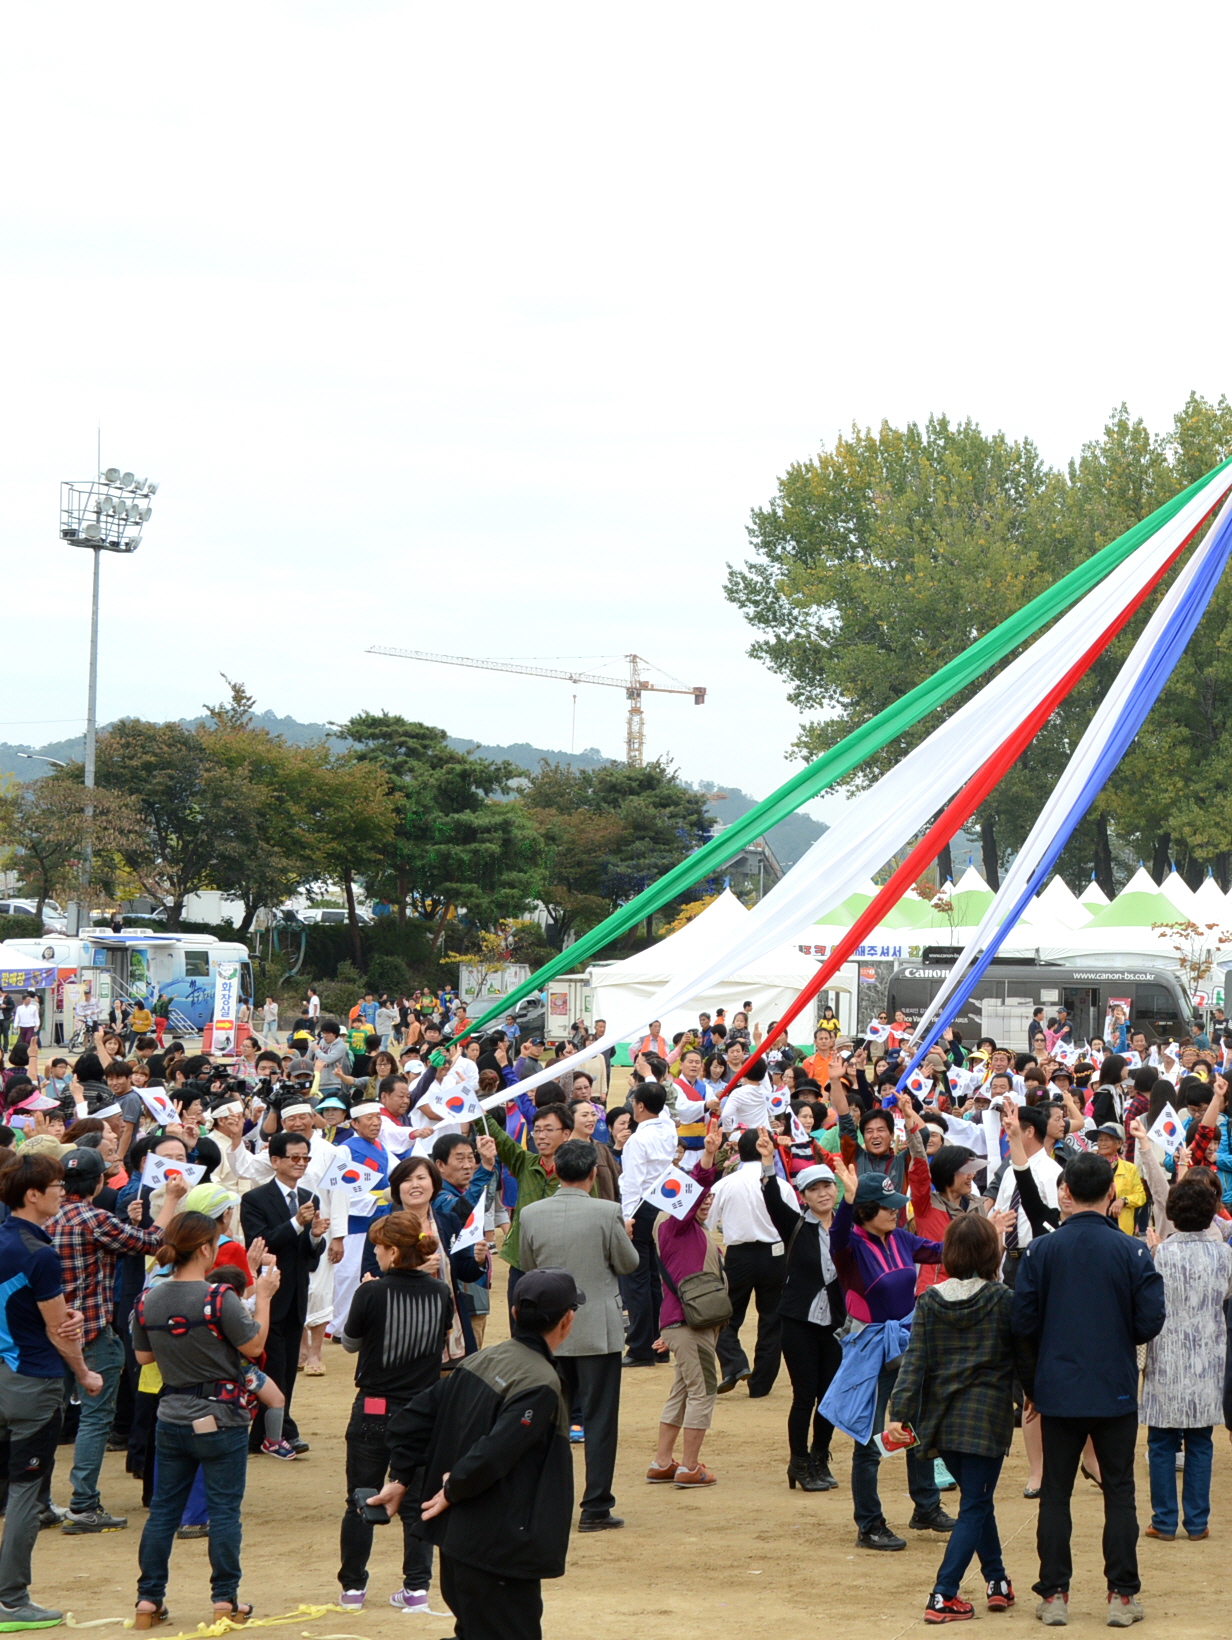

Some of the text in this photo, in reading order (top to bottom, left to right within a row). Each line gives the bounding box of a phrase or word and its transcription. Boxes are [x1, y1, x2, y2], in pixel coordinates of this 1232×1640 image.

[904, 968, 950, 978] Canon
[1073, 971, 1156, 981] www.canon-bs.co.kr
[220, 981, 233, 1018] 화장실
